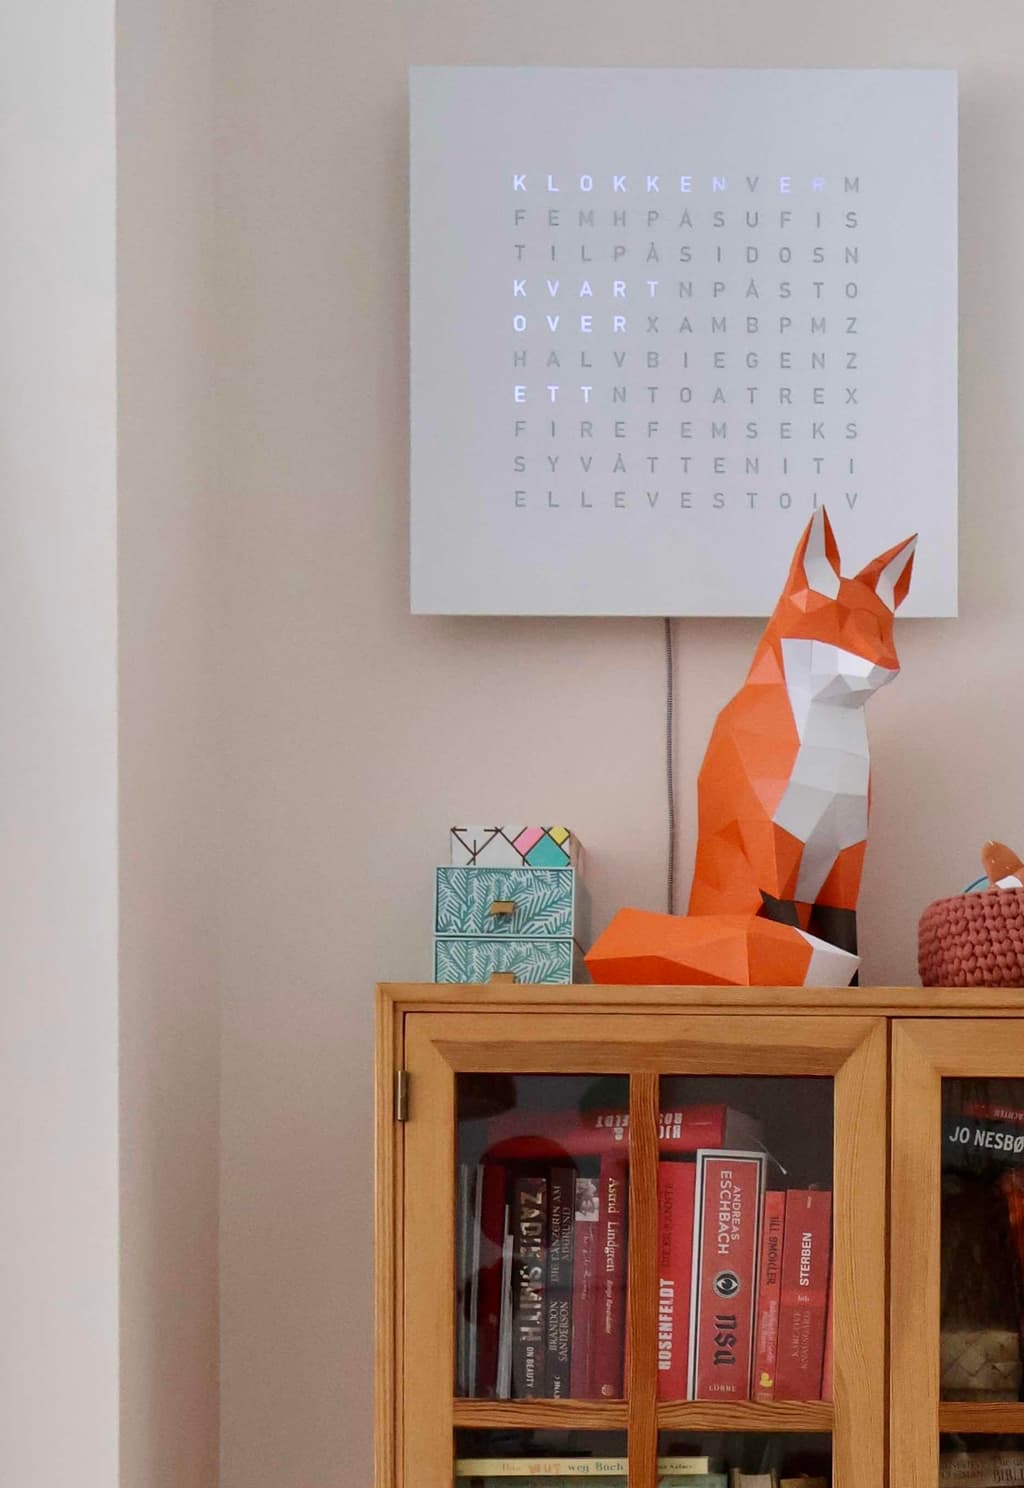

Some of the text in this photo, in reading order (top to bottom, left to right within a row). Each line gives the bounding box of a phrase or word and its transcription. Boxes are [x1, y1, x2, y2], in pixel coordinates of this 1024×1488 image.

[949, 1126, 970, 1144] JO
[603, 1178, 620, 1272] Astrid Lindgren
[717, 1170, 732, 1254] ESCHBACH
[730, 1185, 742, 1241] ANDREAS
[769, 1215, 780, 1232] JILL
[519, 1191, 543, 1342] ZADIE SMITH
[799, 1233, 813, 1286] STERBEN
[547, 1300, 559, 1351] BRANDON
[558, 1300, 569, 1361] SANDERSON
[658, 1278, 675, 1371] ROSENFELDT
[525, 1346, 535, 1388] ON BEAUTY
